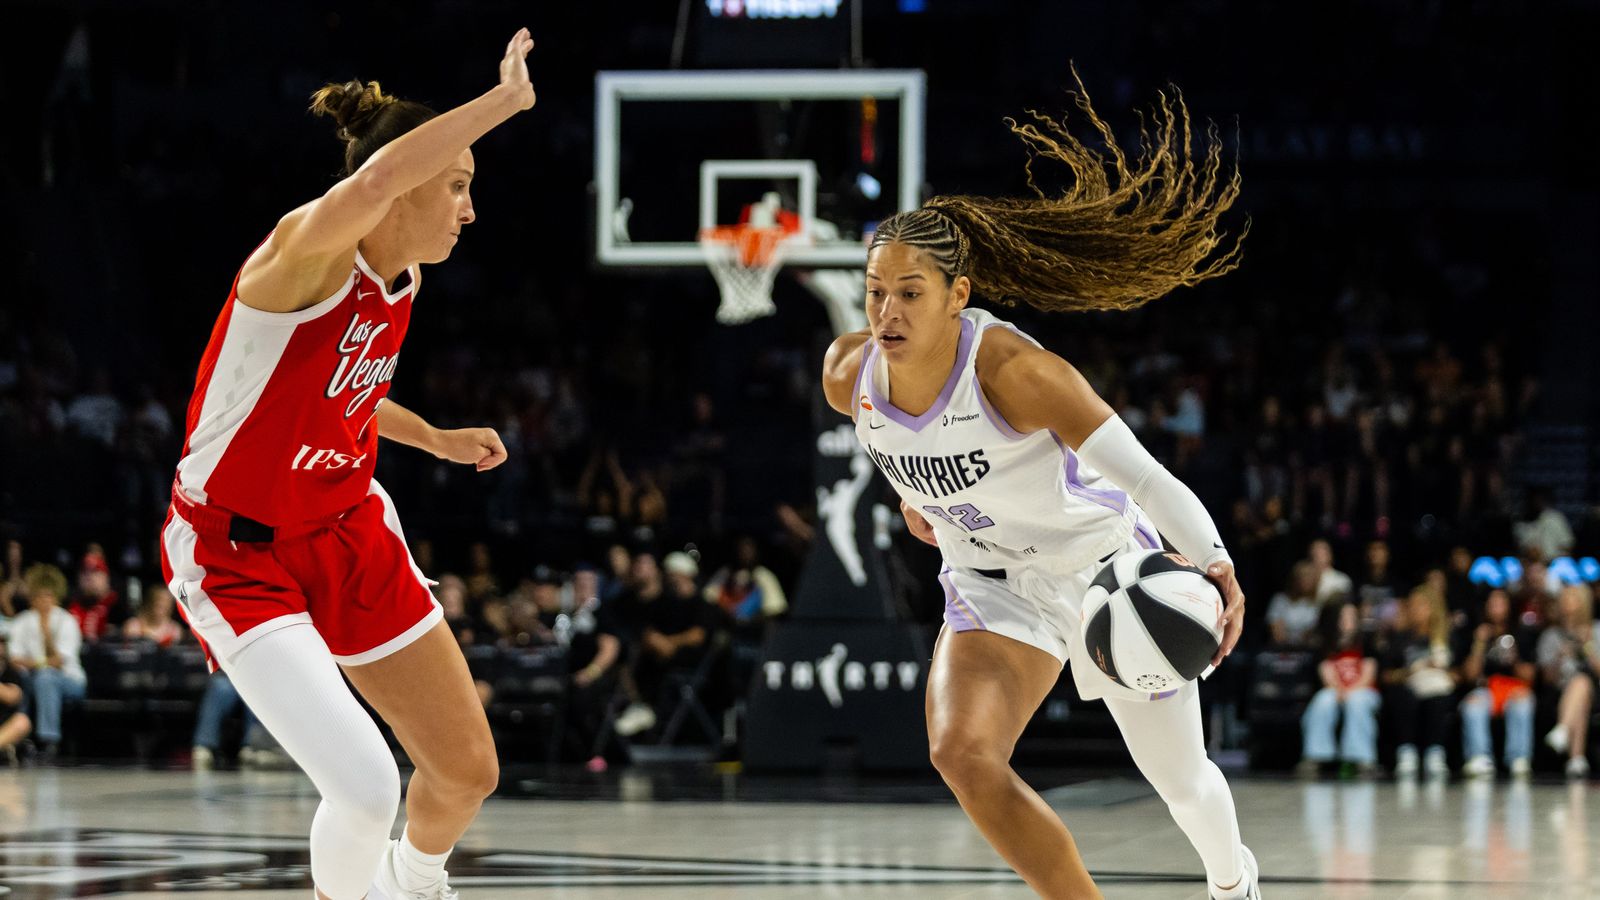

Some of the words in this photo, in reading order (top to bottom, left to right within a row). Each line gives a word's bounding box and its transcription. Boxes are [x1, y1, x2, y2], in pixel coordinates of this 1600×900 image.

[339, 313, 372, 353] Las
[326, 323, 400, 417] Vega
[951, 414, 980, 425] freedom
[868, 443, 990, 498] VALKYRIES
